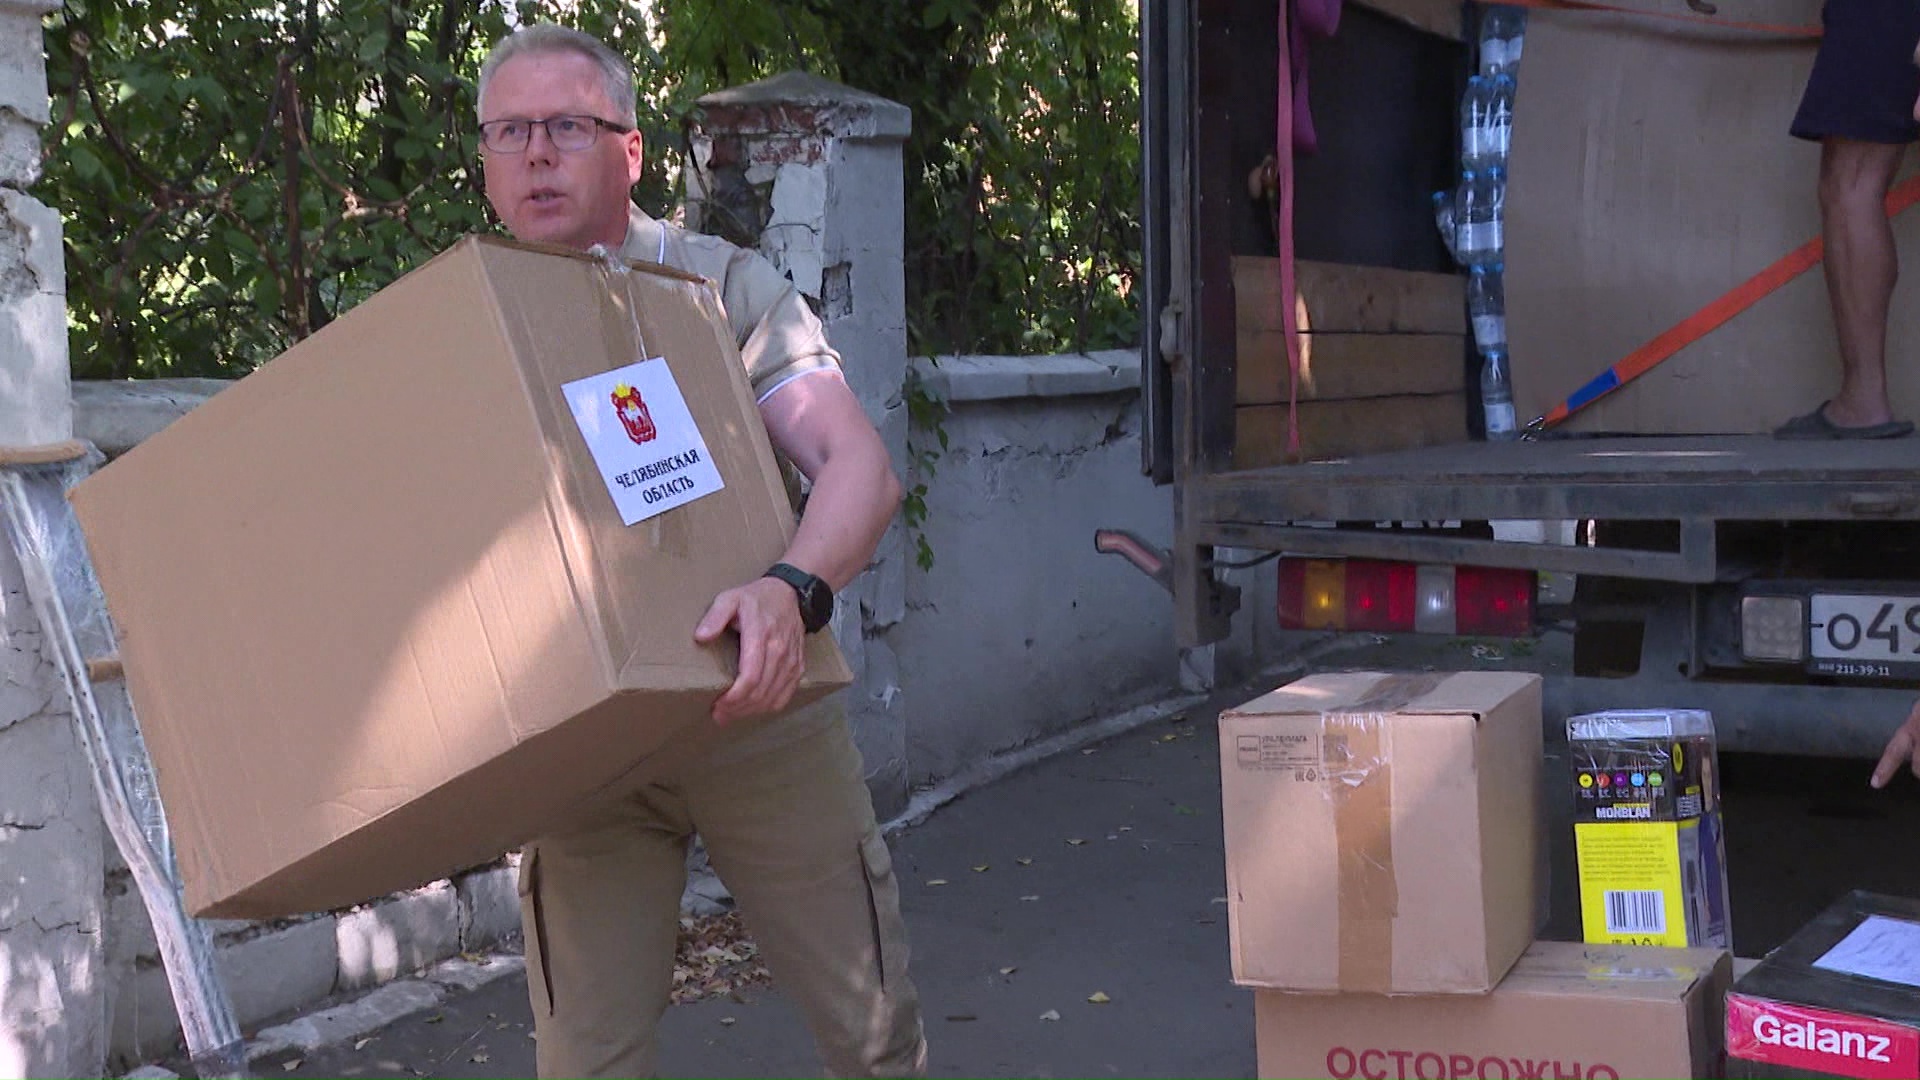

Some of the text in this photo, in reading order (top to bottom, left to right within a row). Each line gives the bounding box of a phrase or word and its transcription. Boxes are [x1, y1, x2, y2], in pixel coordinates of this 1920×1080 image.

[615, 449, 700, 489] ЧЕЛЯБИНСКАЯ
[642, 475, 695, 504] ОБЛАСТЬ
[1596, 806, 1651, 818] MONBLAN
[1753, 1014, 1890, 1063] Galanz
